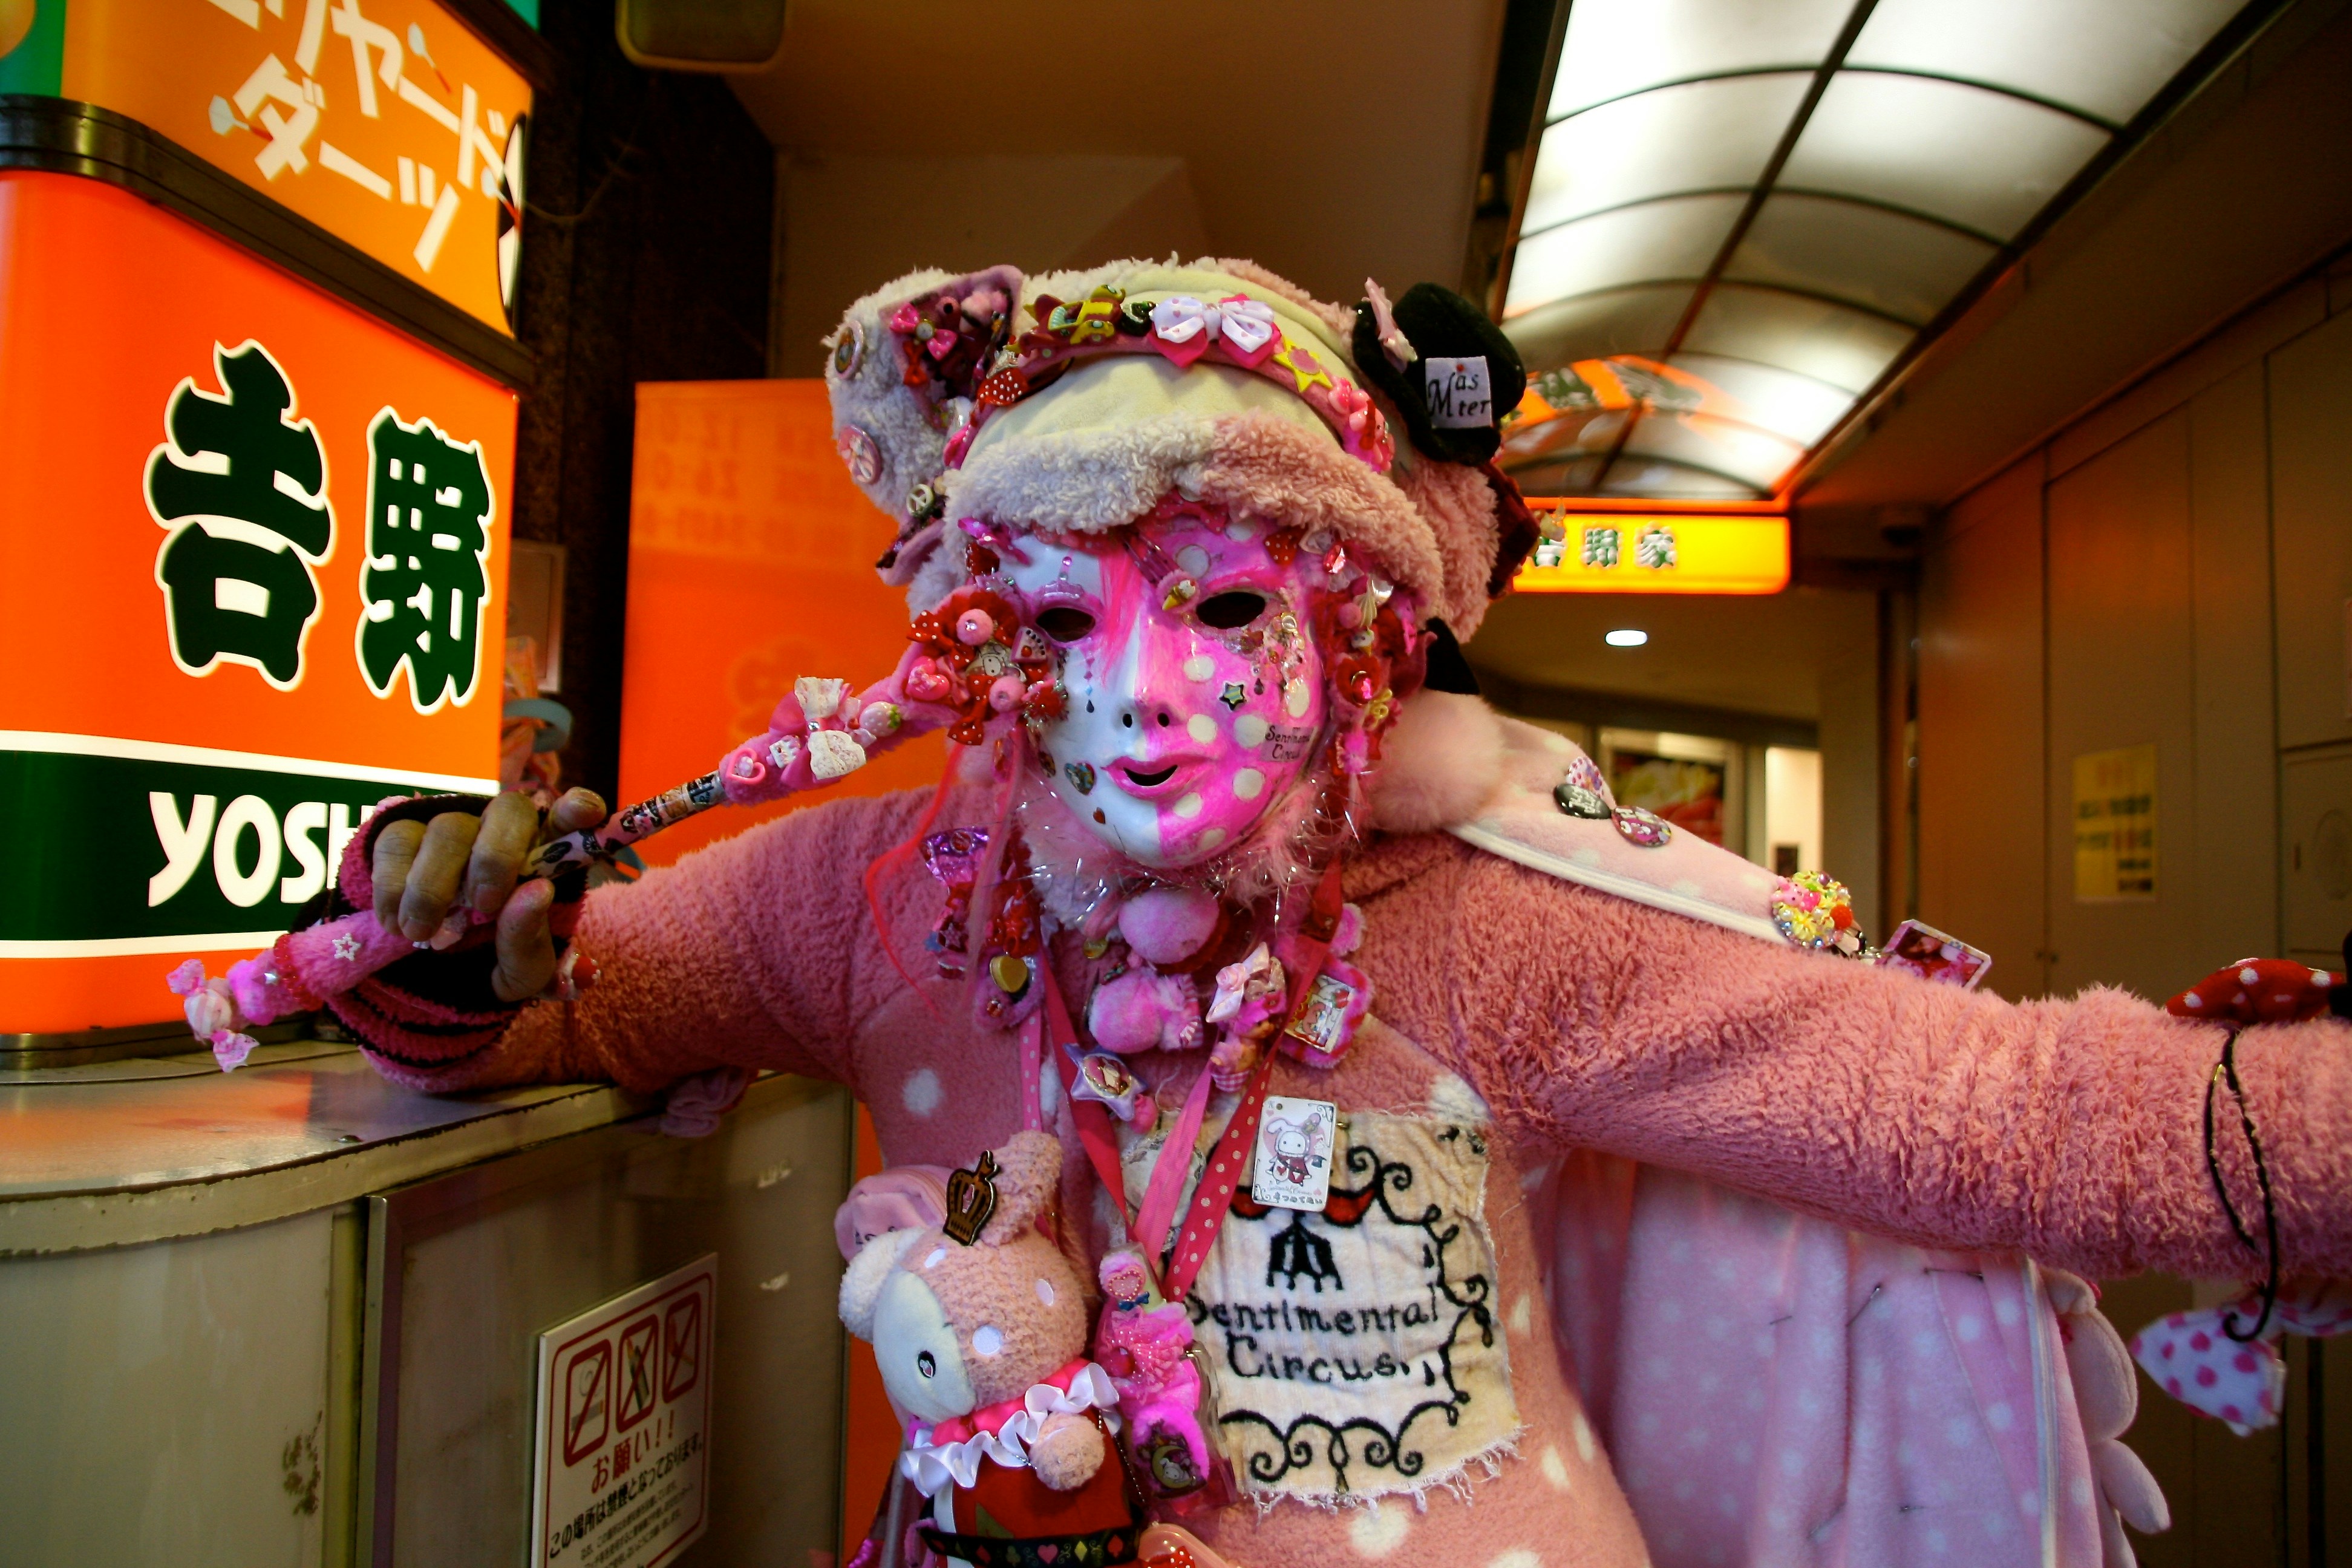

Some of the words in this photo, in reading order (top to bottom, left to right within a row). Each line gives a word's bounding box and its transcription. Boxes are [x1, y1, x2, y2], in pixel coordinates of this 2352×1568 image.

[207, 0, 507, 190] リヤード
[232, 52, 460, 273] ダーツ
